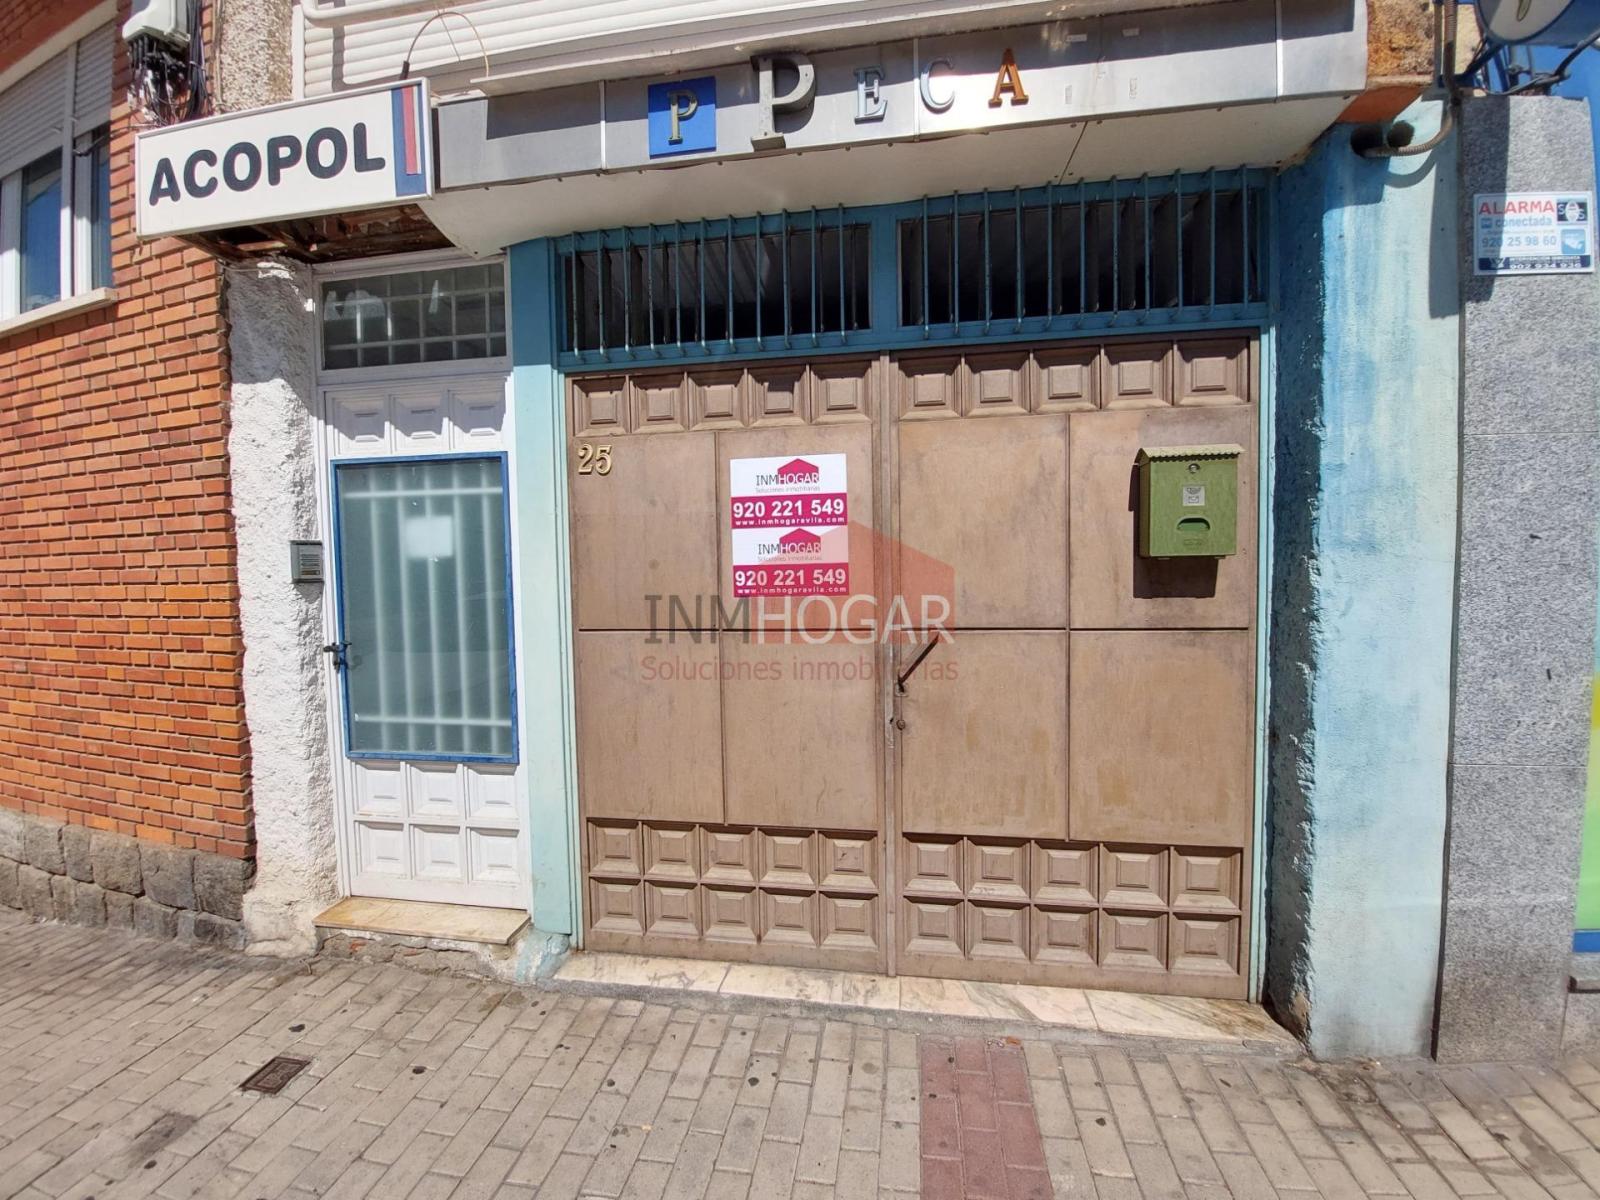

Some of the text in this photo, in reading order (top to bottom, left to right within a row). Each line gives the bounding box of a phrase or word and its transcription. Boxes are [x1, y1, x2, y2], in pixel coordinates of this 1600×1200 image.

[668, 88, 698, 146] P
[149, 122, 386, 206] ACOPOL
[1478, 199, 1555, 215] ALARMA
[1495, 215, 1552, 228] conectada
[1482, 236, 1503, 248] 920
[1507, 236, 1521, 247] 25
[1542, 235, 1557, 246] 60
[578, 443, 612, 475] 25
[755, 472, 819, 486] INMHOGAR
[733, 498, 844, 518] 920 221 549
[735, 516, 845, 526] www.inmhogaravila.com
[757, 542, 821, 555] INMHOGAR
[735, 568, 846, 587] 920 221 549
